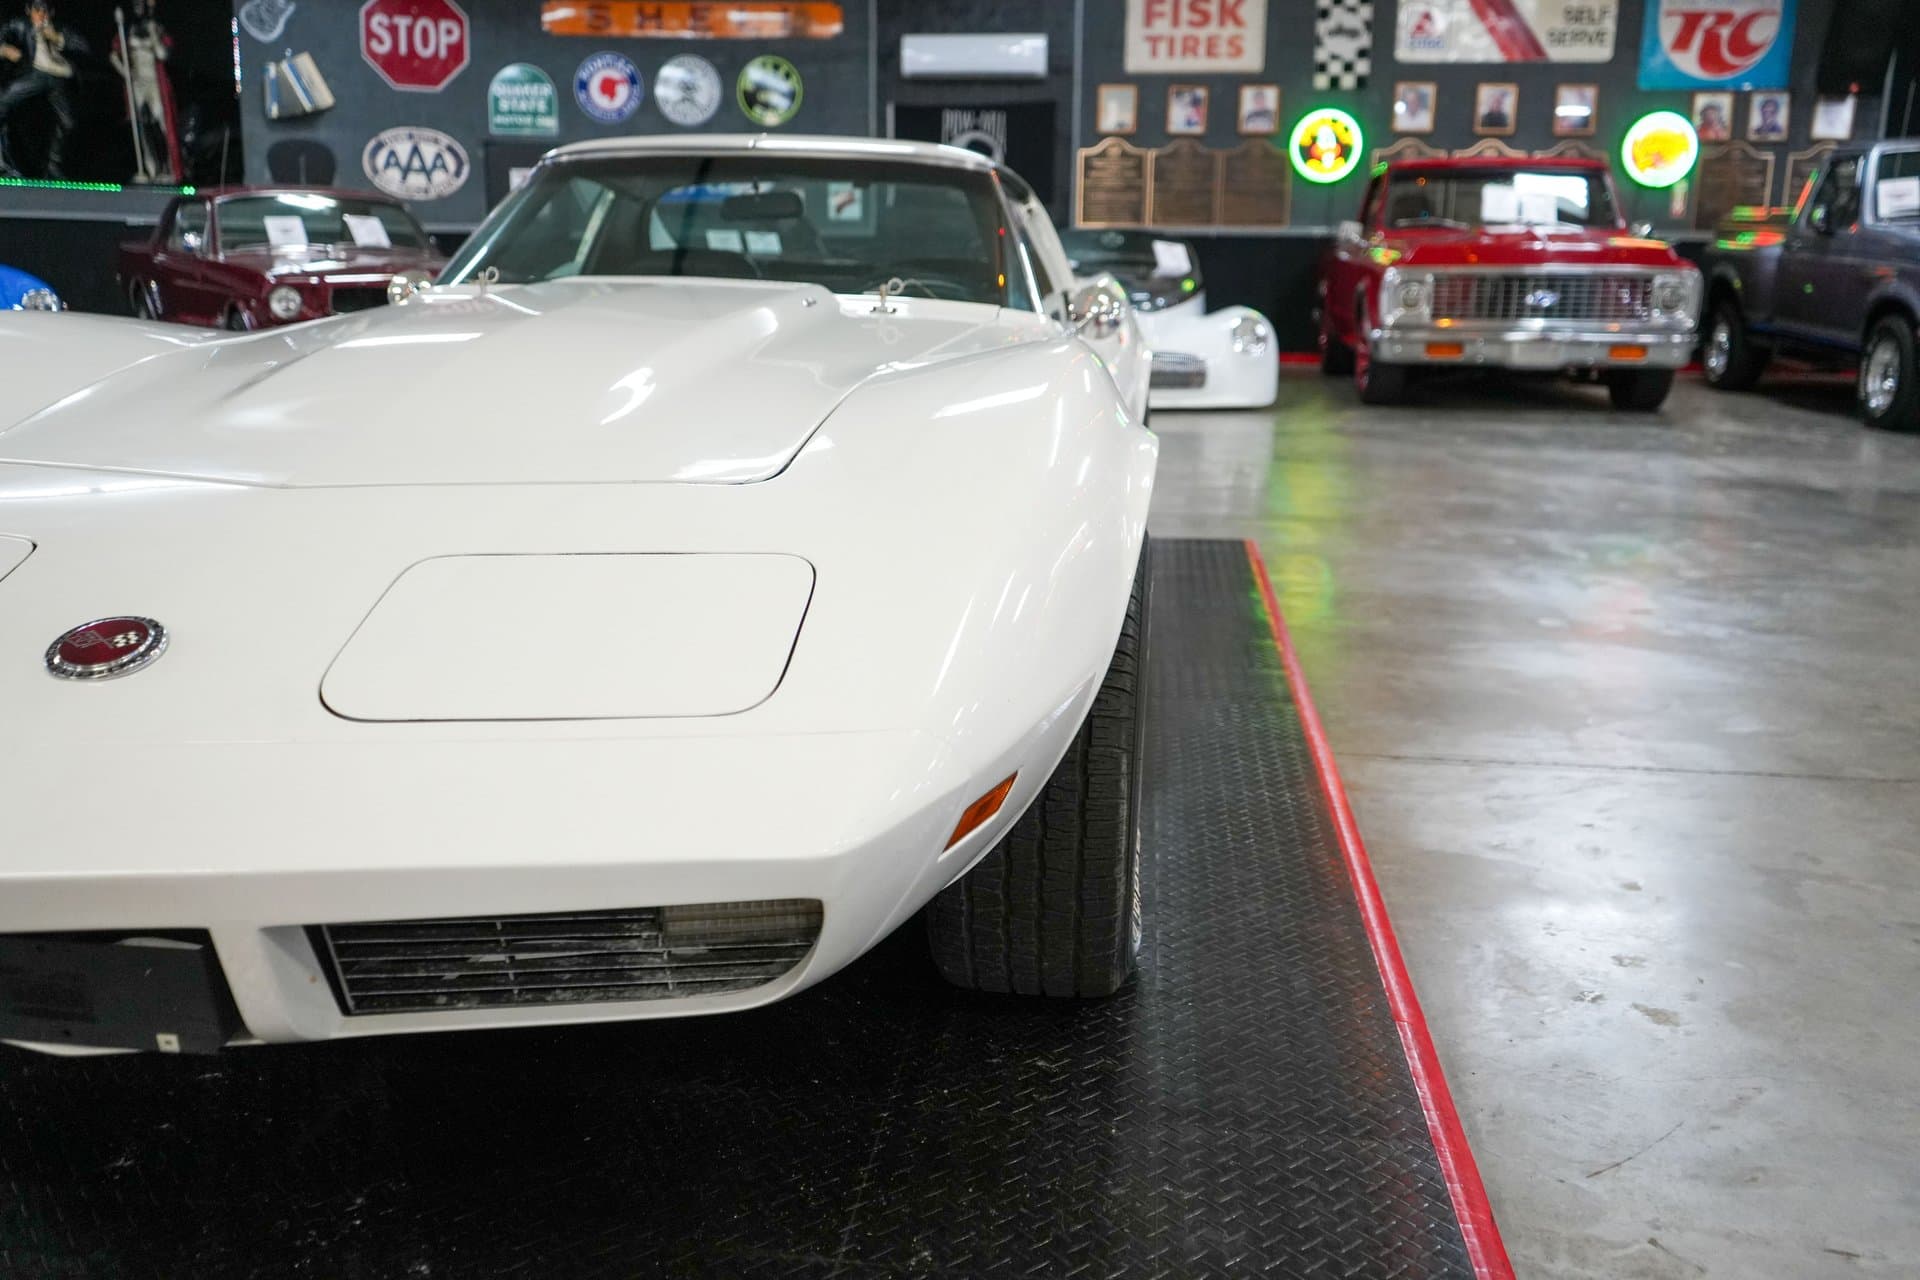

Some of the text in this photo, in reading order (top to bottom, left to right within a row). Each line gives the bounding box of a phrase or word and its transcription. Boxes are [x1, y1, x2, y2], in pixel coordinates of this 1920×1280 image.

[1144, 0, 1247, 28] FISK
[1563, 6, 1611, 25] SELF
[369, 15, 461, 59] STOP
[1144, 34, 1245, 59] TIRES
[1546, 27, 1609, 47] SERVE
[1664, 9, 1779, 77] RC
[492, 83, 553, 97] QUAKER
[498, 98, 547, 113] STATE
[383, 143, 449, 185] AAA
